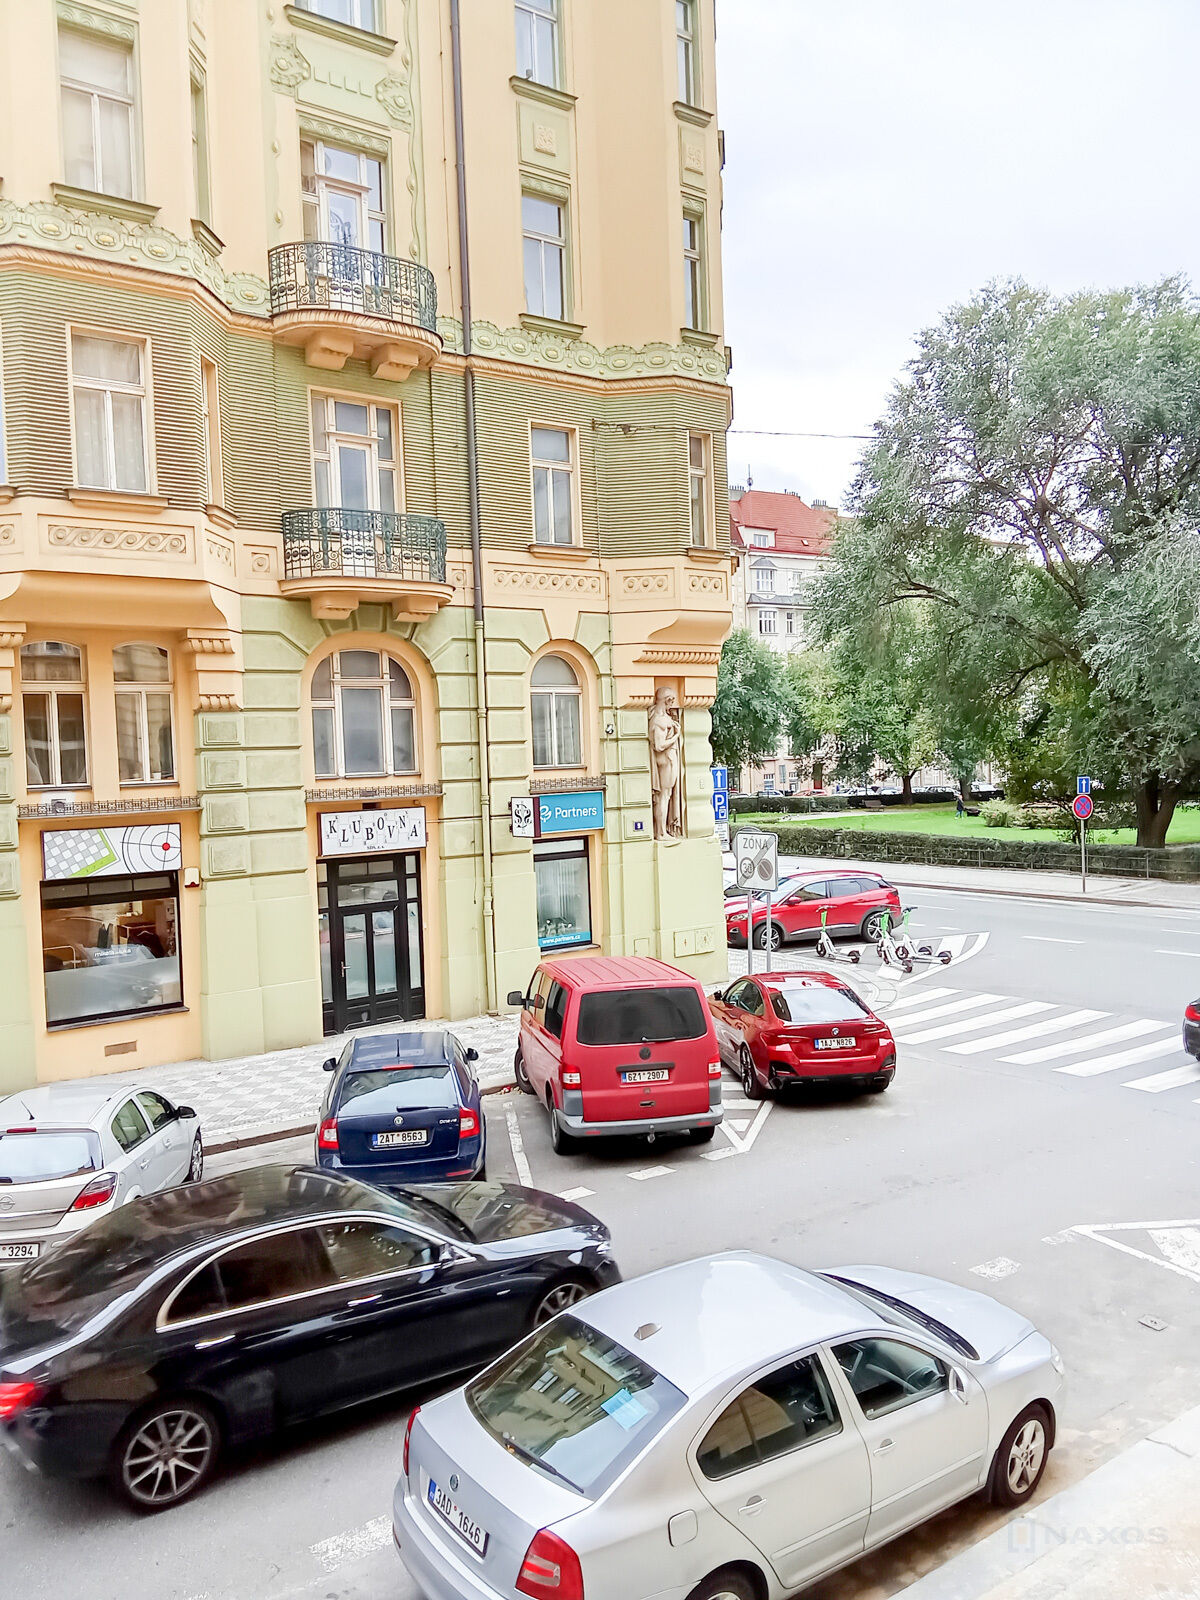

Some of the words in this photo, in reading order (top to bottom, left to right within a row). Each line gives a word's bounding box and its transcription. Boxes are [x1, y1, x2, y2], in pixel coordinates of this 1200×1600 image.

[714, 793, 725, 812] P
[555, 806, 598, 819] Partners
[328, 815, 418, 843] KLUBOVNA
[742, 835, 769, 850] ZÓNA
[627, 1072, 642, 1082] 6Z1
[647, 1070, 665, 1080] 2907
[379, 1134, 396, 1144] 2AT
[401, 1131, 423, 1142] 8563
[8, 1245, 33, 1257] 3294
[435, 1488, 452, 1516] 3AD
[458, 1511, 481, 1544] 1646
